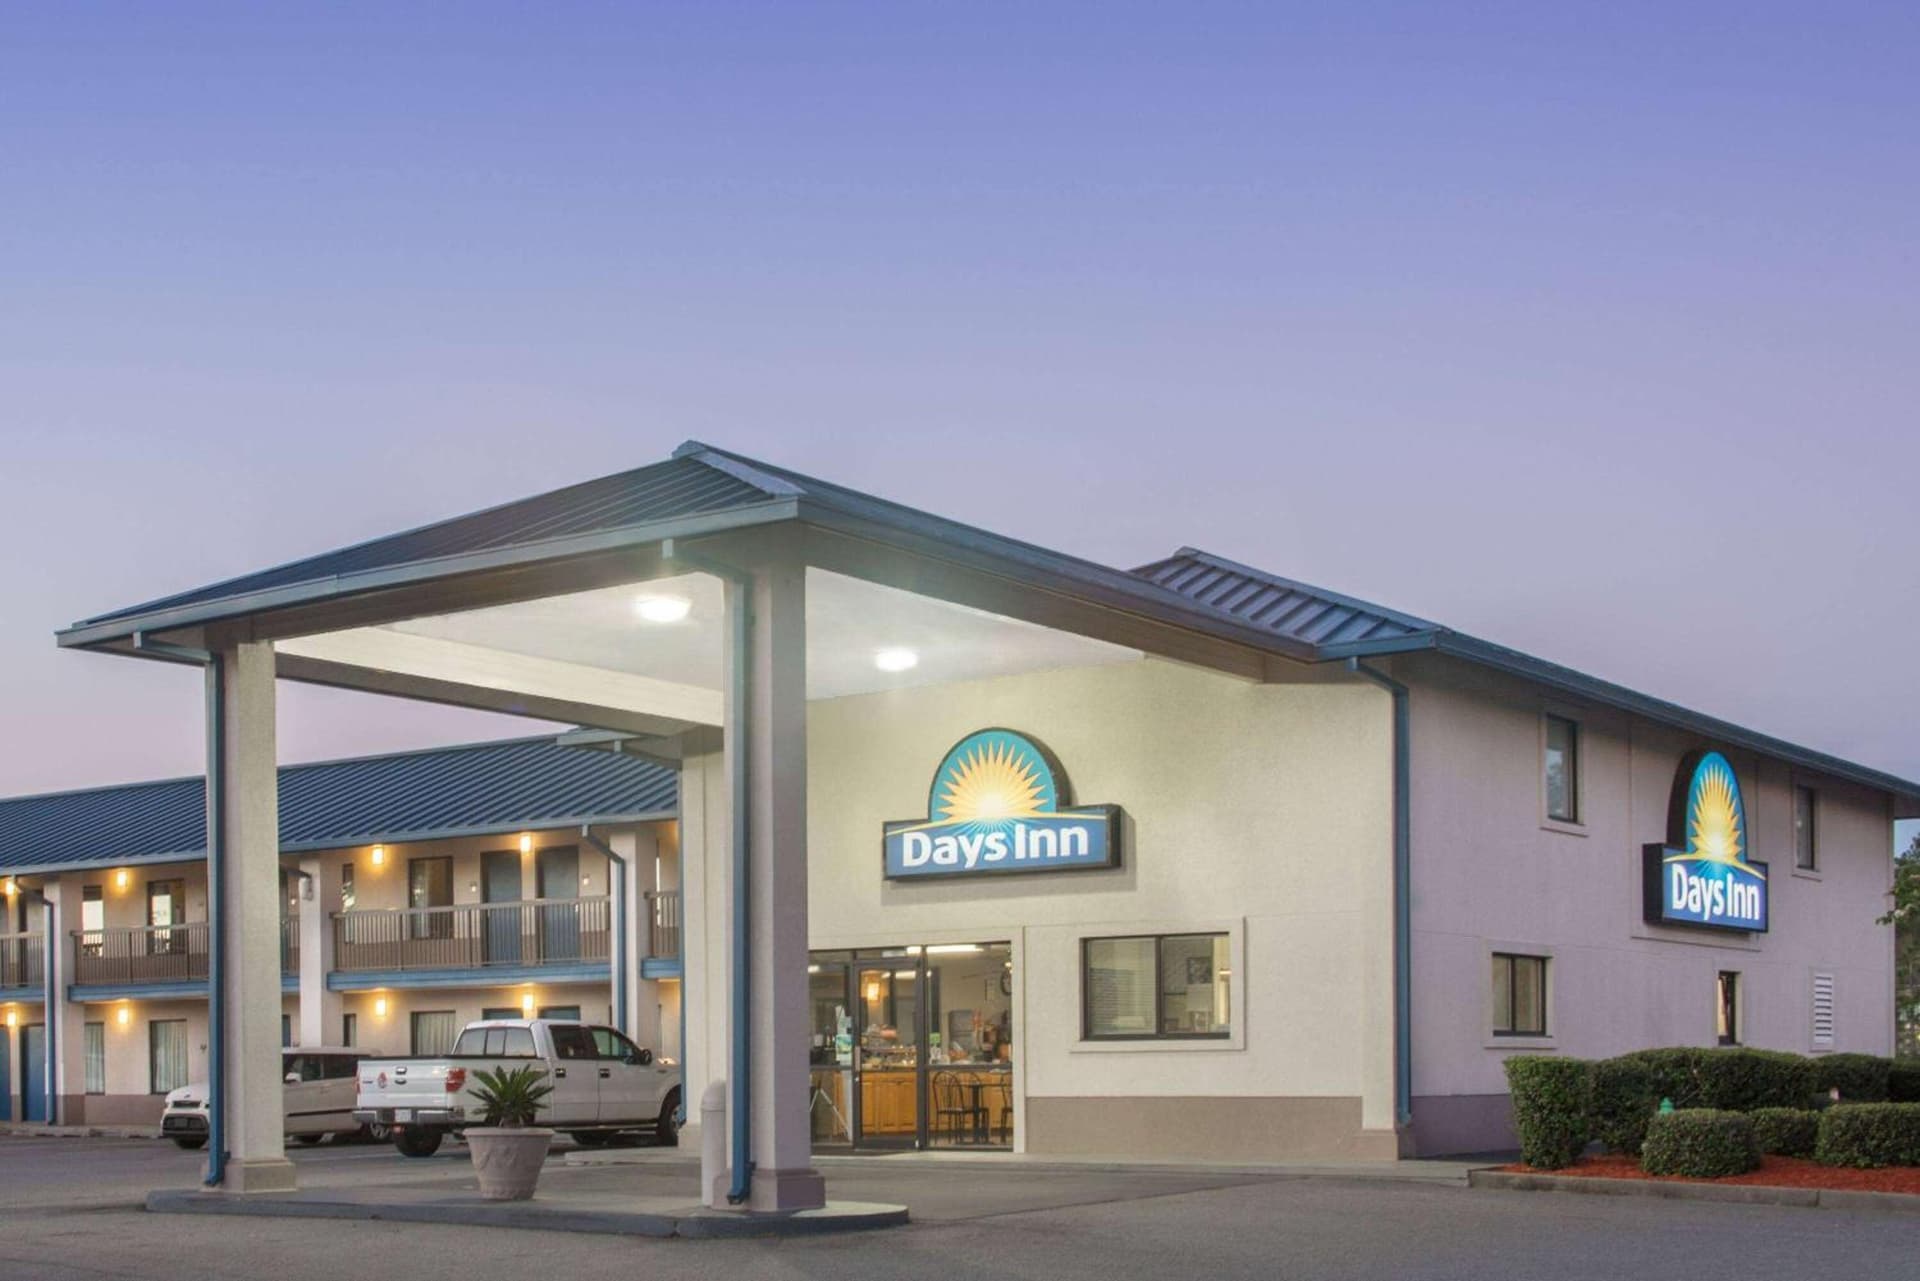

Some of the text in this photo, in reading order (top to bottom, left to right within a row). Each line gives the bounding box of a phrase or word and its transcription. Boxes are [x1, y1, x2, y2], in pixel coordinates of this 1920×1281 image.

[903, 823, 1089, 869] Days Inn
[1672, 864, 1760, 920] Days Inn
